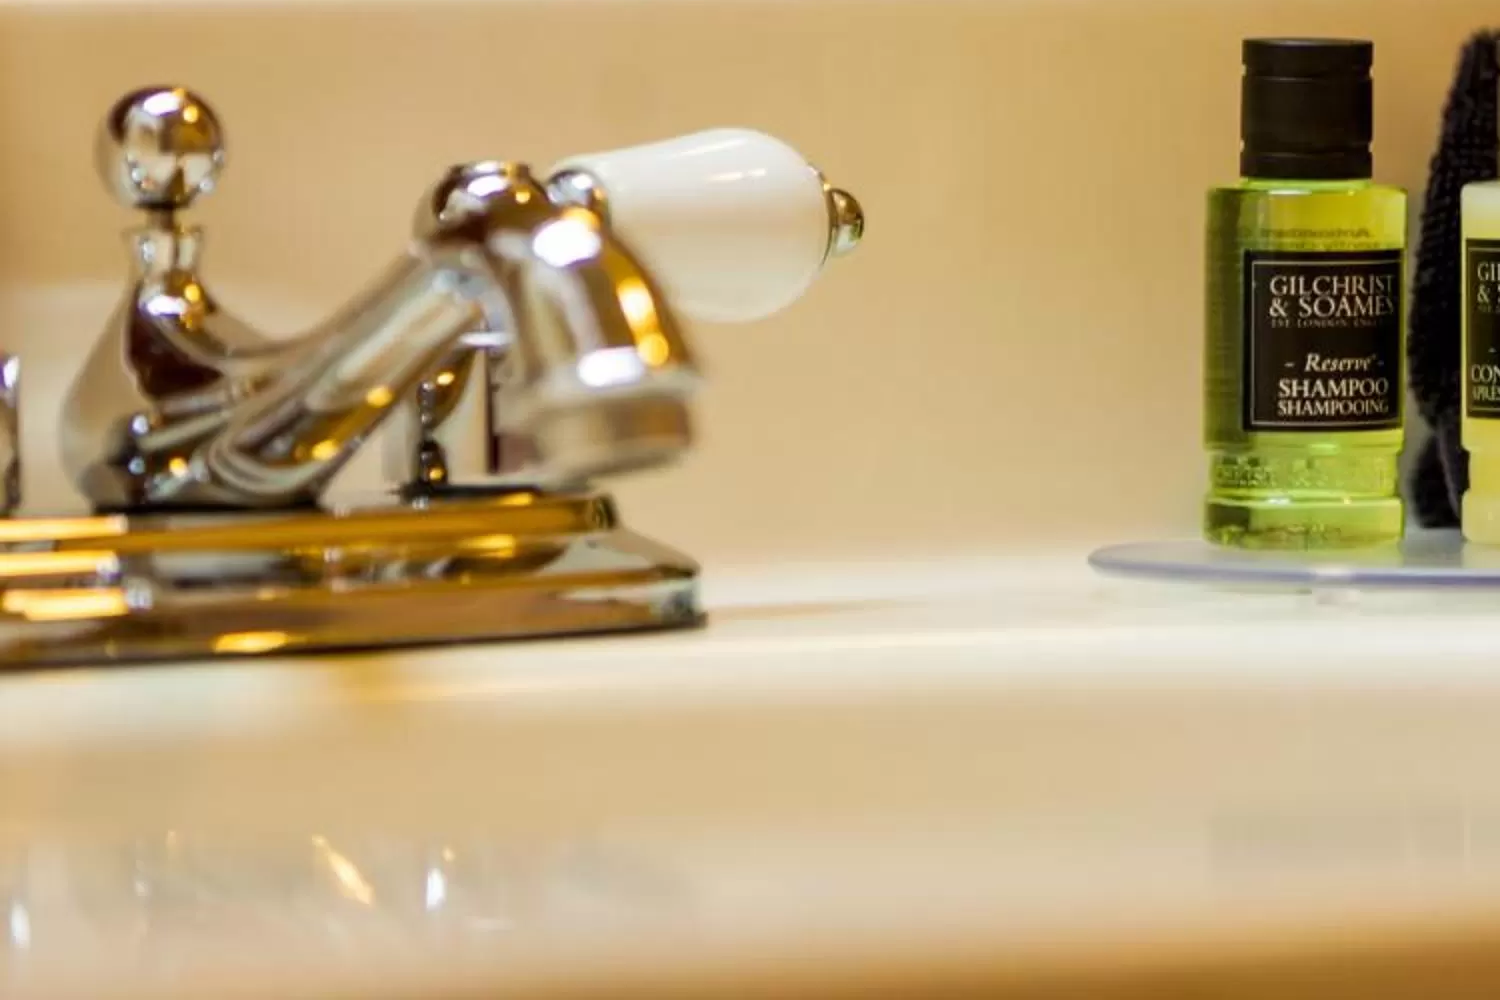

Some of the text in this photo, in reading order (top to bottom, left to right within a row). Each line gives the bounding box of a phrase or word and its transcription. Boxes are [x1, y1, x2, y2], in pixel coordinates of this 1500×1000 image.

[1269, 275, 1395, 296] GILCHRIST
[1477, 285, 1490, 304] &
[1269, 297, 1288, 317] &
[1304, 352, 1371, 373] Reserve
[1278, 377, 1389, 398] SHAMPOO
[1277, 399, 1389, 416] SHAMPOOING
